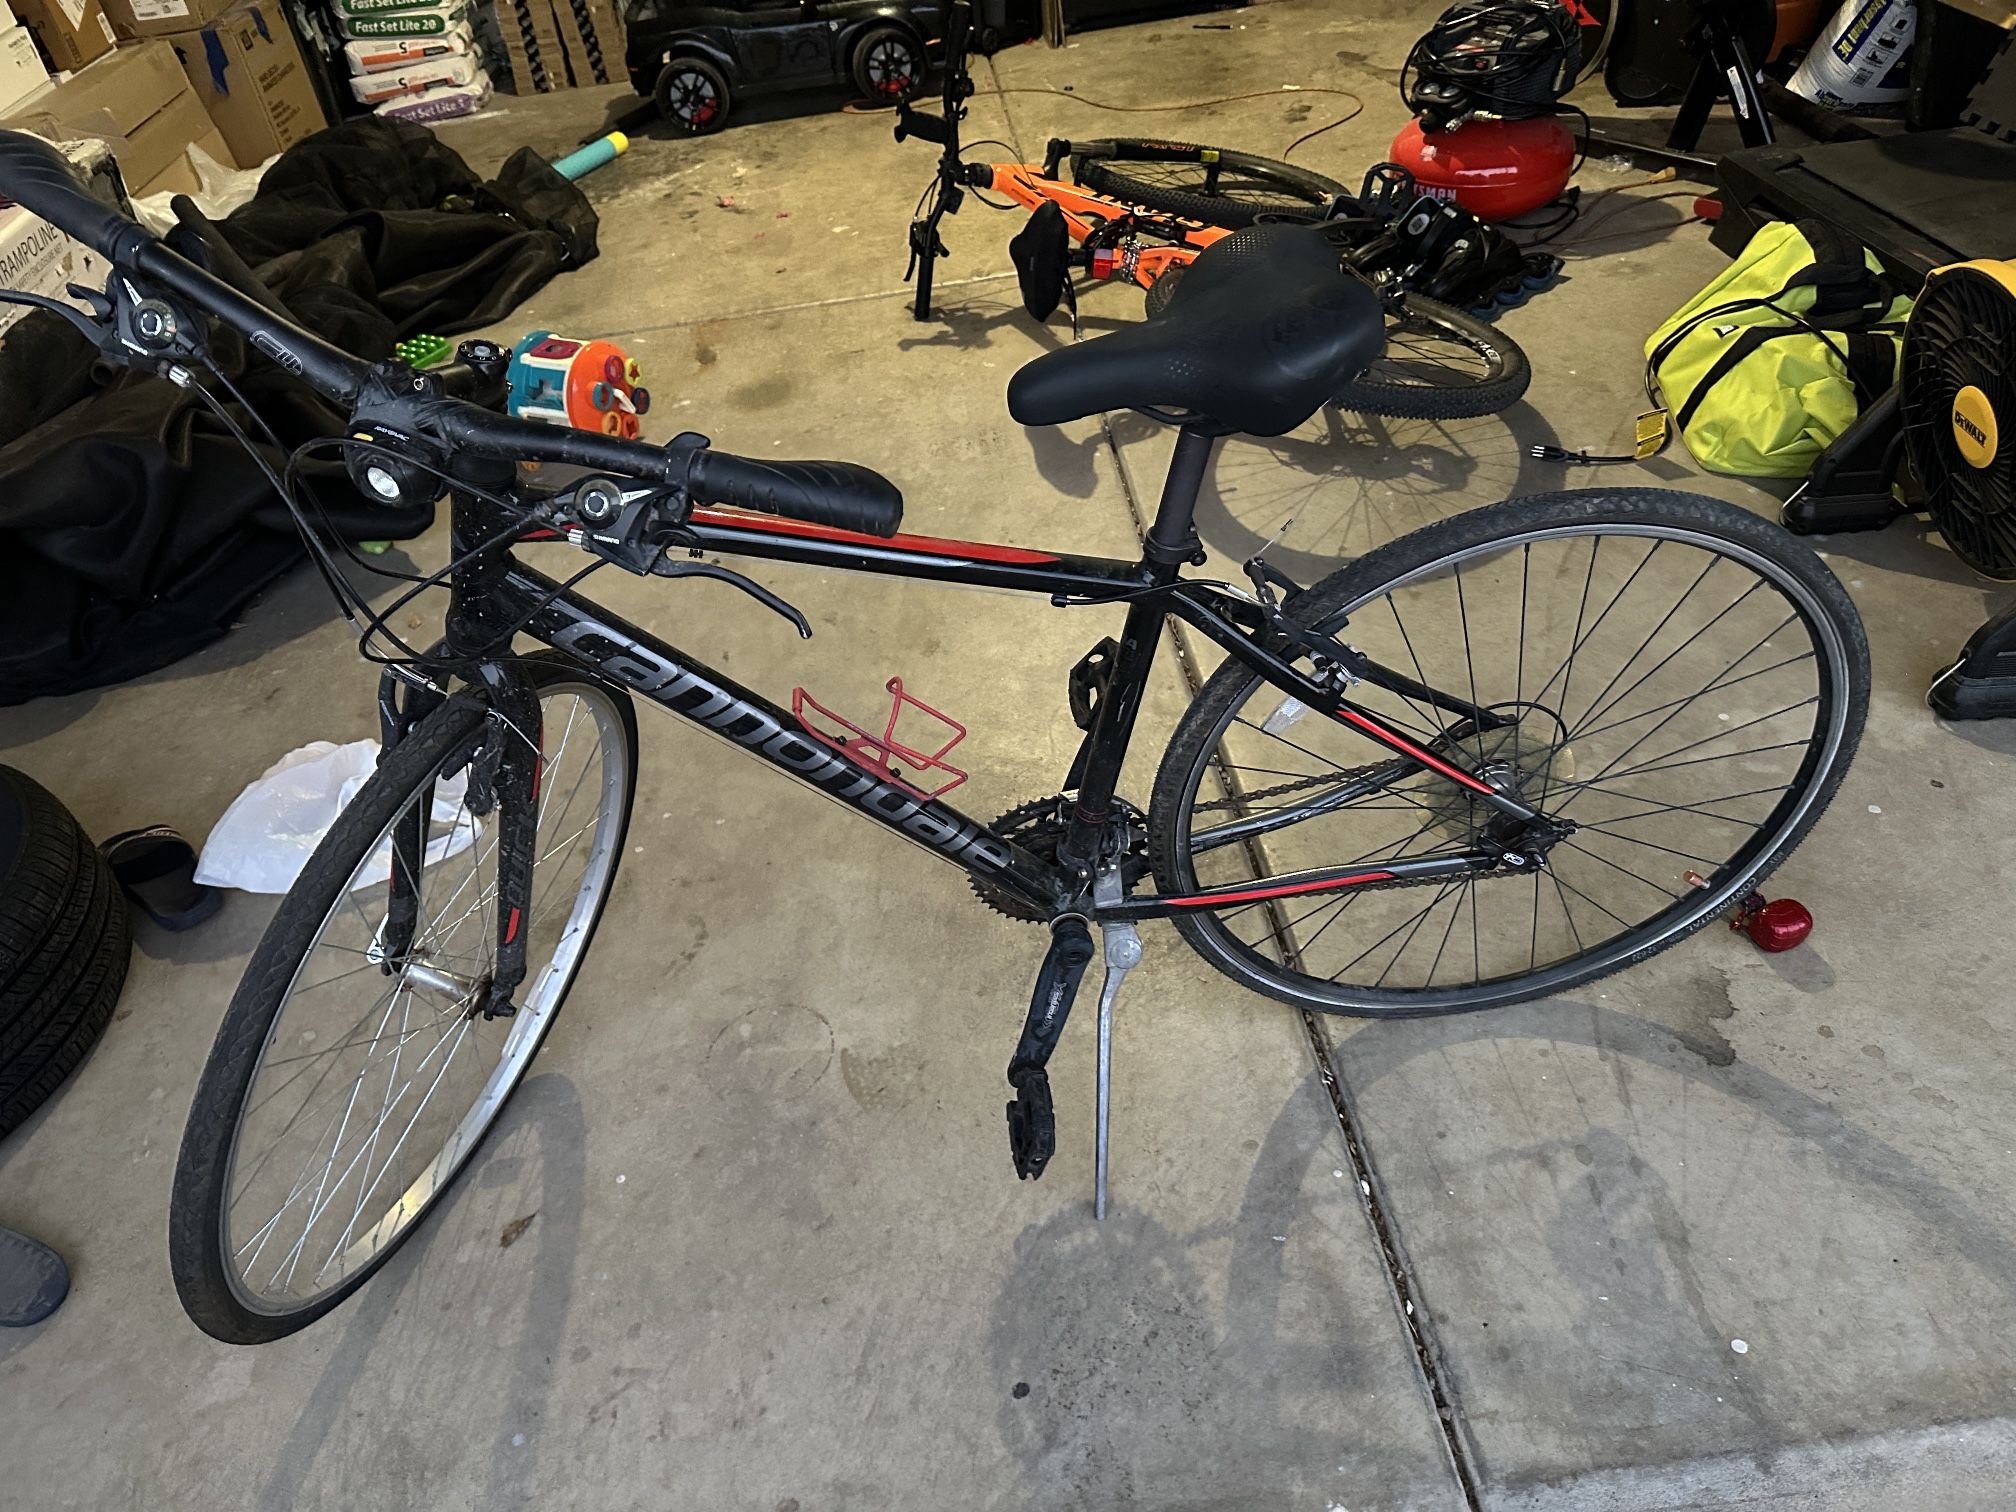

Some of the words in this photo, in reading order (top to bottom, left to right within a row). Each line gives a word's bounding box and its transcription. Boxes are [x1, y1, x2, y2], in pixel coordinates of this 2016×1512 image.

[355, 21, 378, 33] Fast
[380, 20, 398, 32] Set
[399, 19, 420, 31] Lite
[422, 19, 437, 30] 20
[1413, 183, 1457, 201] TSMAN
[374, 425, 410, 442] RAYOVAC
[1685, 877, 1758, 932] CONTINENTAL
